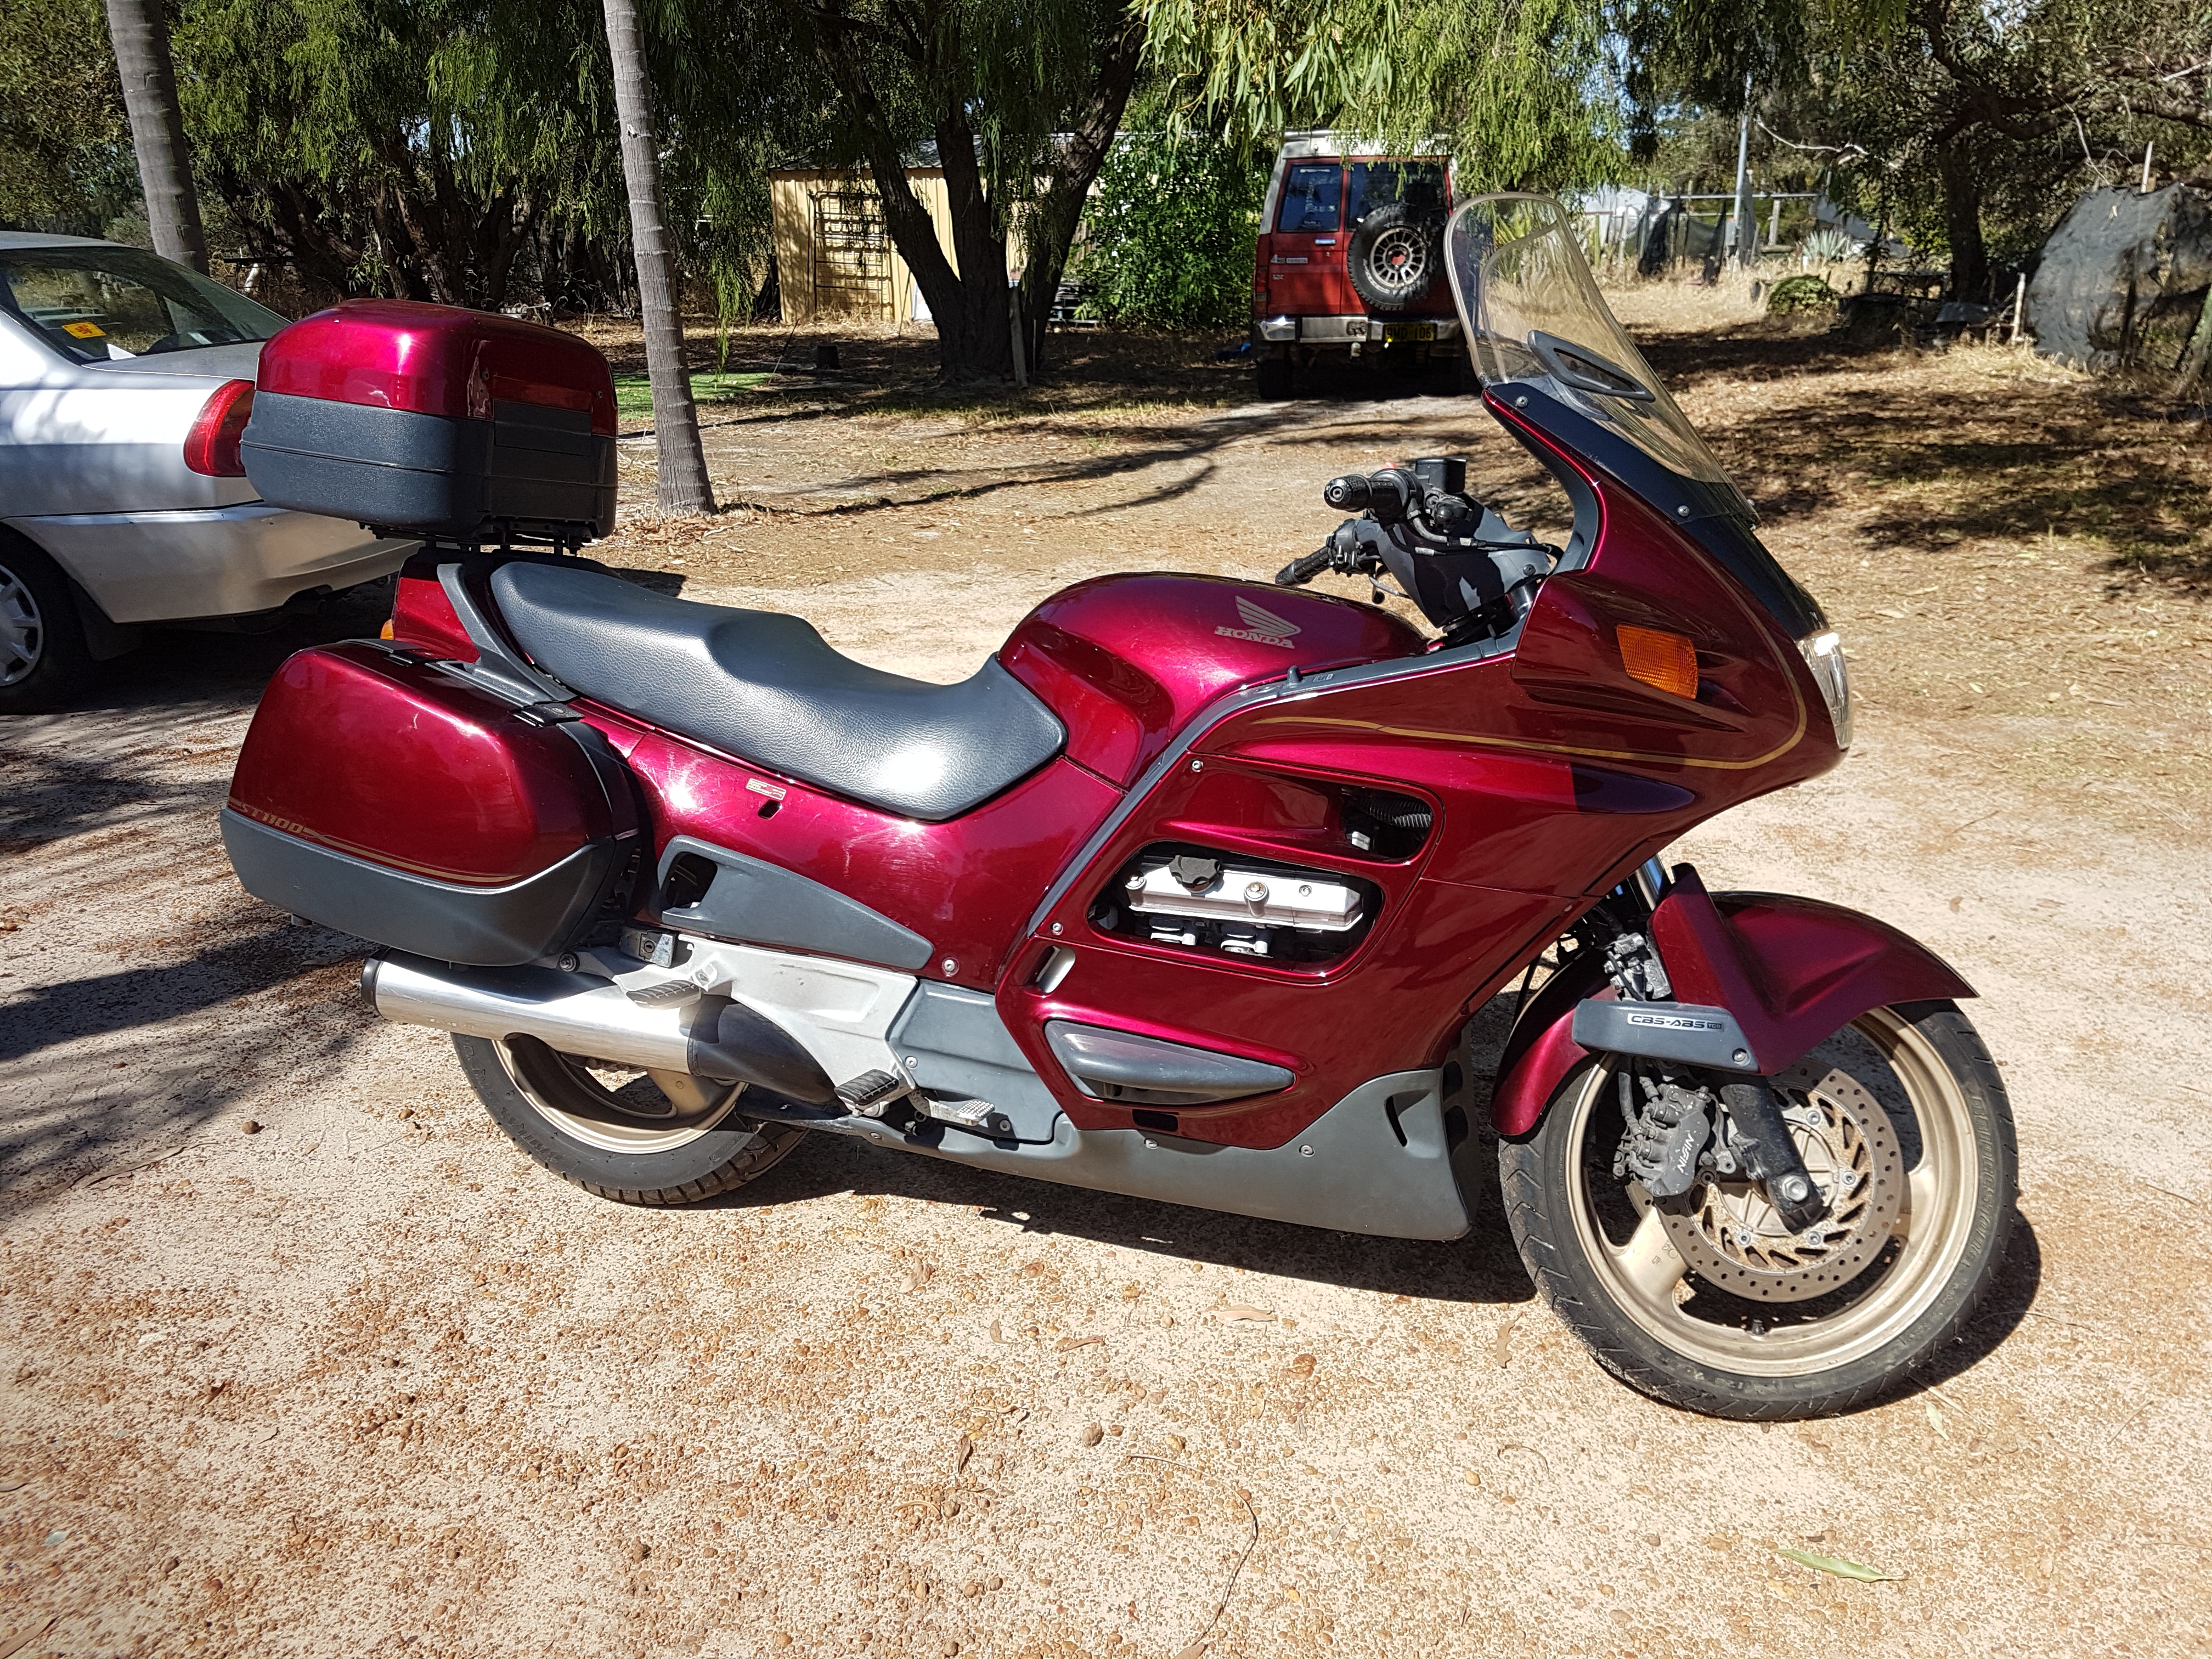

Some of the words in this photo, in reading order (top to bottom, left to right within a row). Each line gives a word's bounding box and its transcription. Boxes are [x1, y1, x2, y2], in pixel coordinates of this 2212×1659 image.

[1214, 626, 1295, 649] HONDA
[239, 803, 304, 834] ST1100
[1631, 1015, 1706, 1029] CBS-ABS
